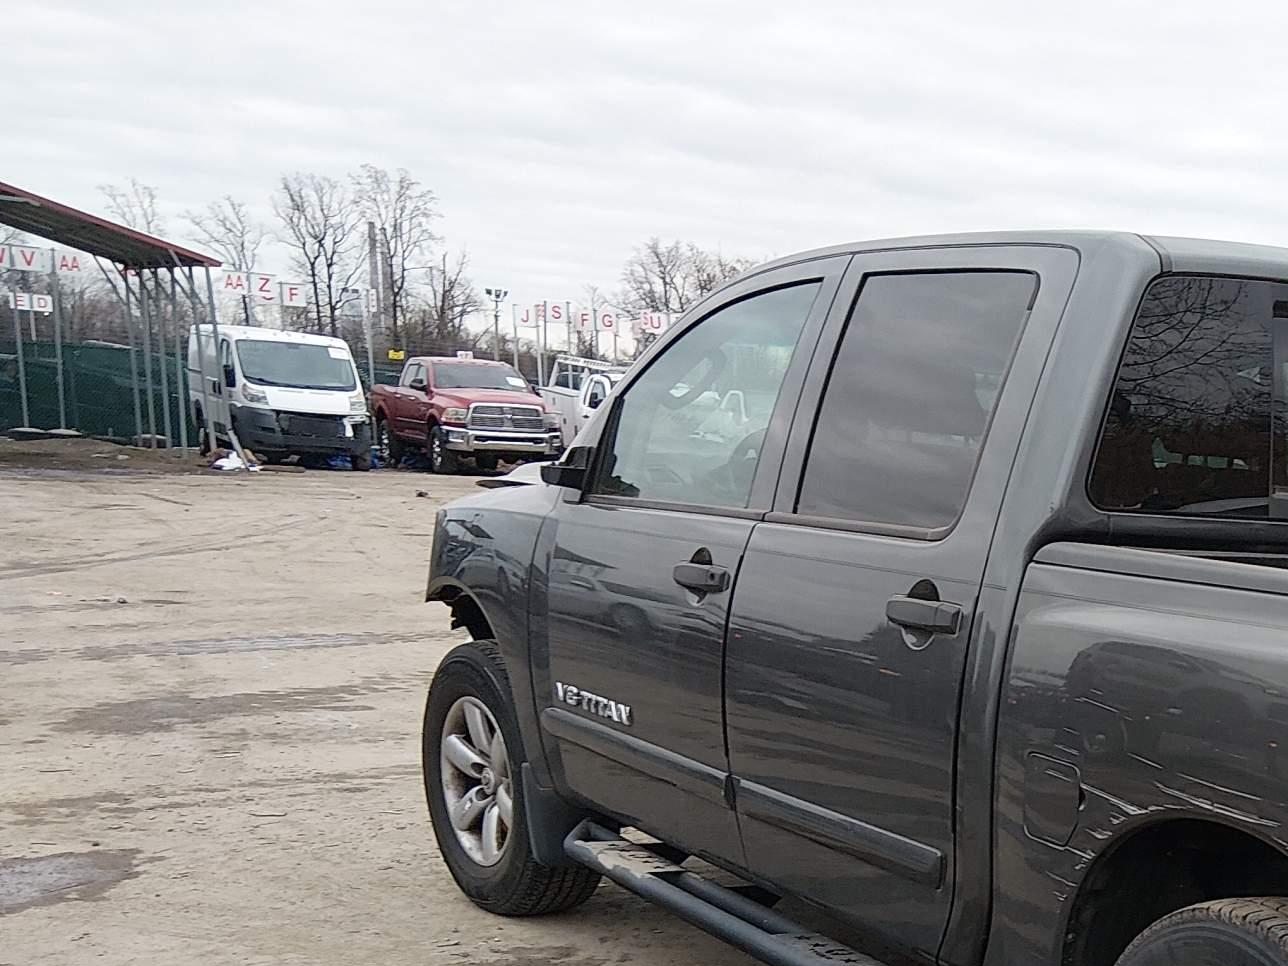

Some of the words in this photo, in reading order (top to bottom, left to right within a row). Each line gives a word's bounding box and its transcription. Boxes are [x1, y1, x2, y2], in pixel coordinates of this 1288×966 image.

[20, 249, 35, 267] V
[59, 255, 81, 271] AA
[224, 273, 245, 290] AA
[258, 277, 271, 292] Z
[288, 287, 298, 302] F
[37, 297, 48, 309] D
[520, 309, 530, 323] J
[551, 305, 562, 320] S
[580, 313, 590, 327] F
[601, 313, 613, 328] G
[649, 315, 661, 329] U
